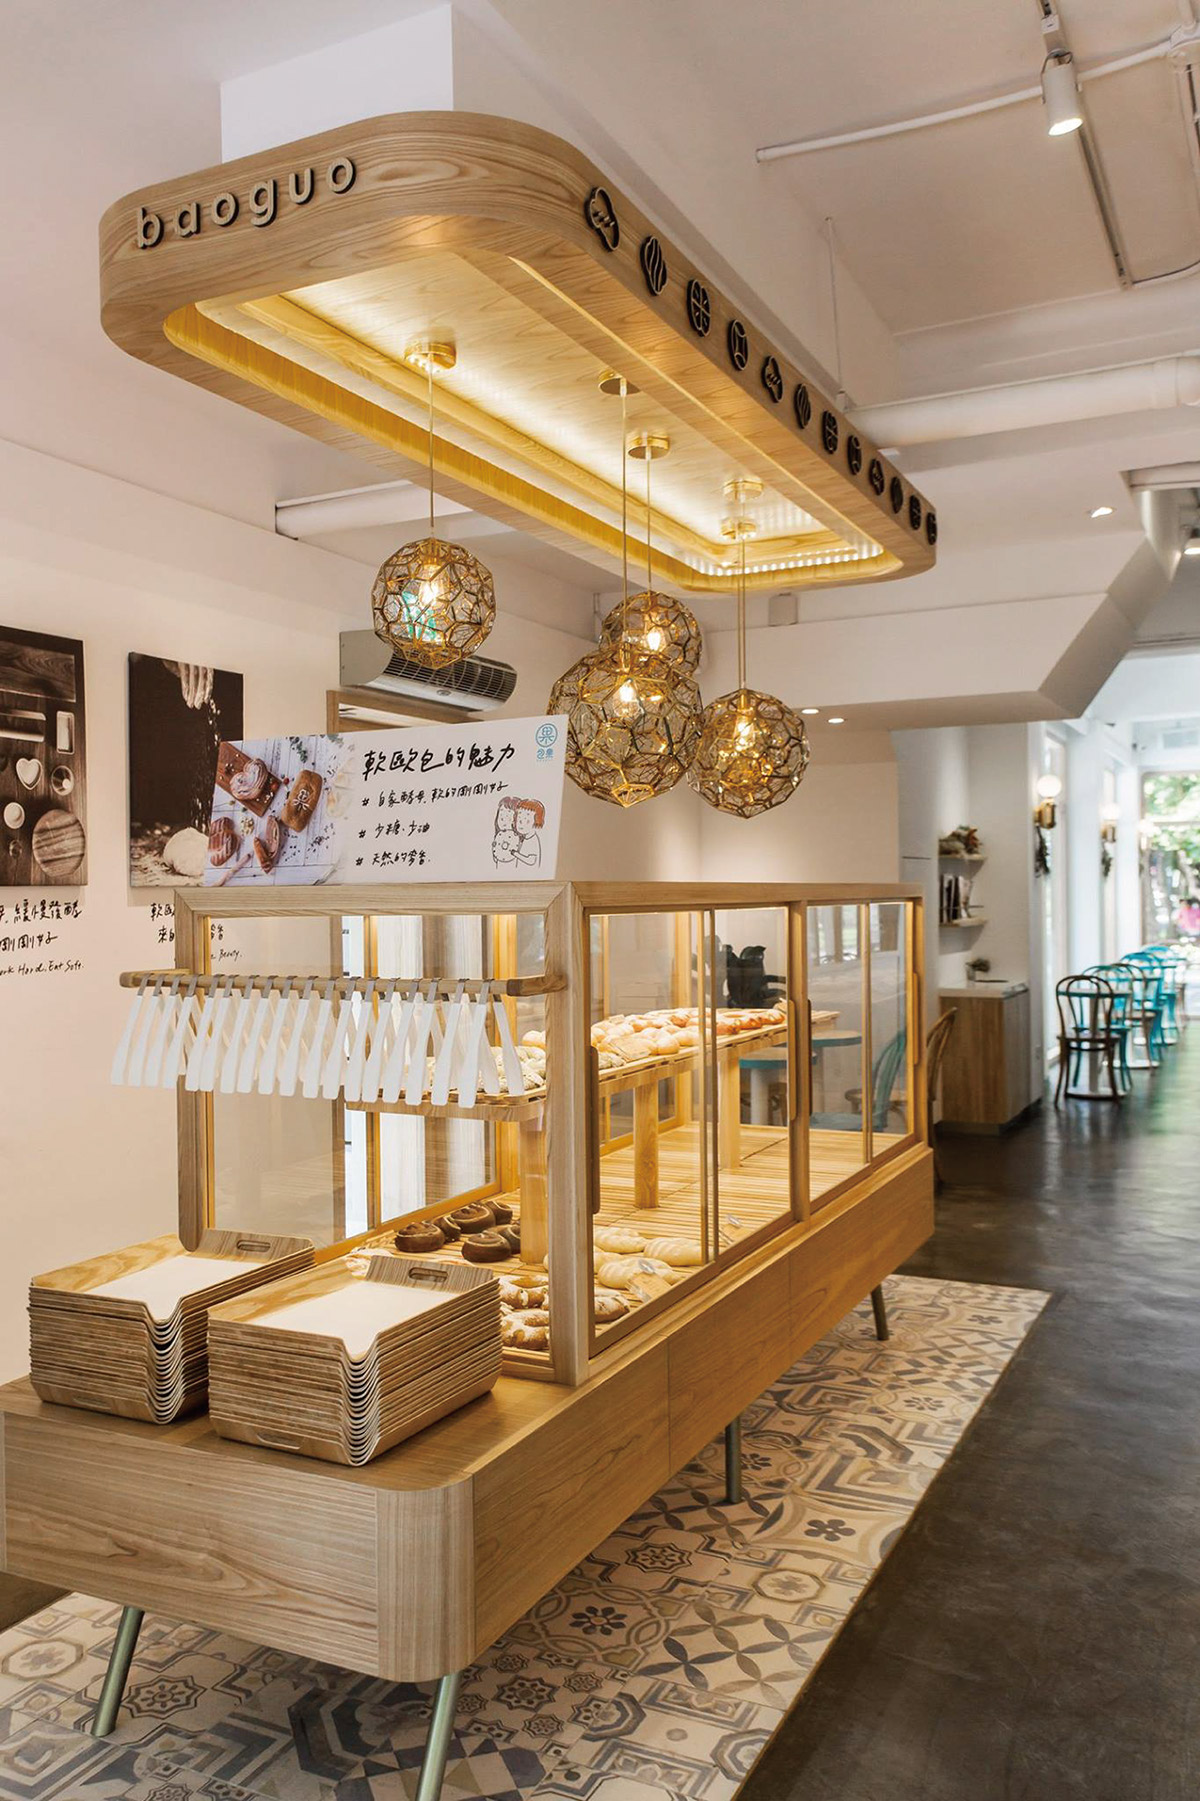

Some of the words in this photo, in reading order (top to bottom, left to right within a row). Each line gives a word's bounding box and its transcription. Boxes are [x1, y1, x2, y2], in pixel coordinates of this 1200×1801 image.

[136, 156, 357, 249] baoguo
[362, 743, 516, 781] 軟歐包的魅力
